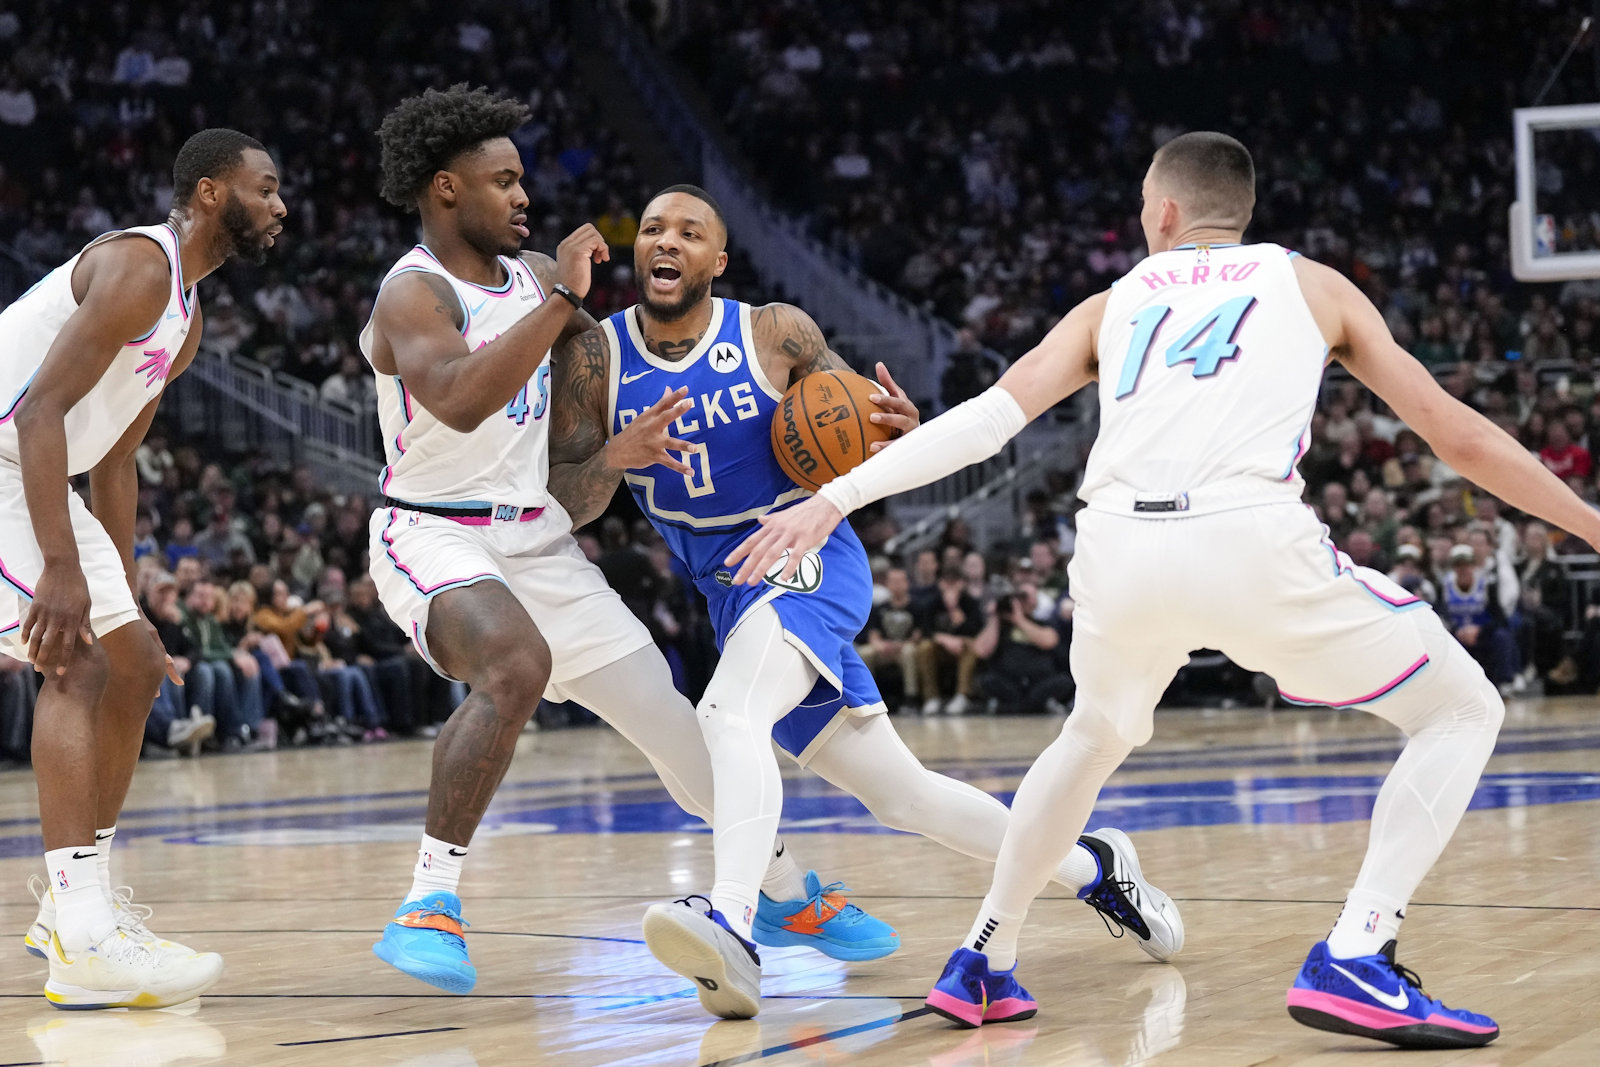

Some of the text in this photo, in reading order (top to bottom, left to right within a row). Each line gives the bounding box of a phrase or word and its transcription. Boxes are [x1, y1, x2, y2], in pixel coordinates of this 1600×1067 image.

[1140, 261, 1261, 291] HERRO
[1114, 295, 1260, 402] 14
[783, 393, 818, 476] Wilson
[680, 442, 716, 499] 0
